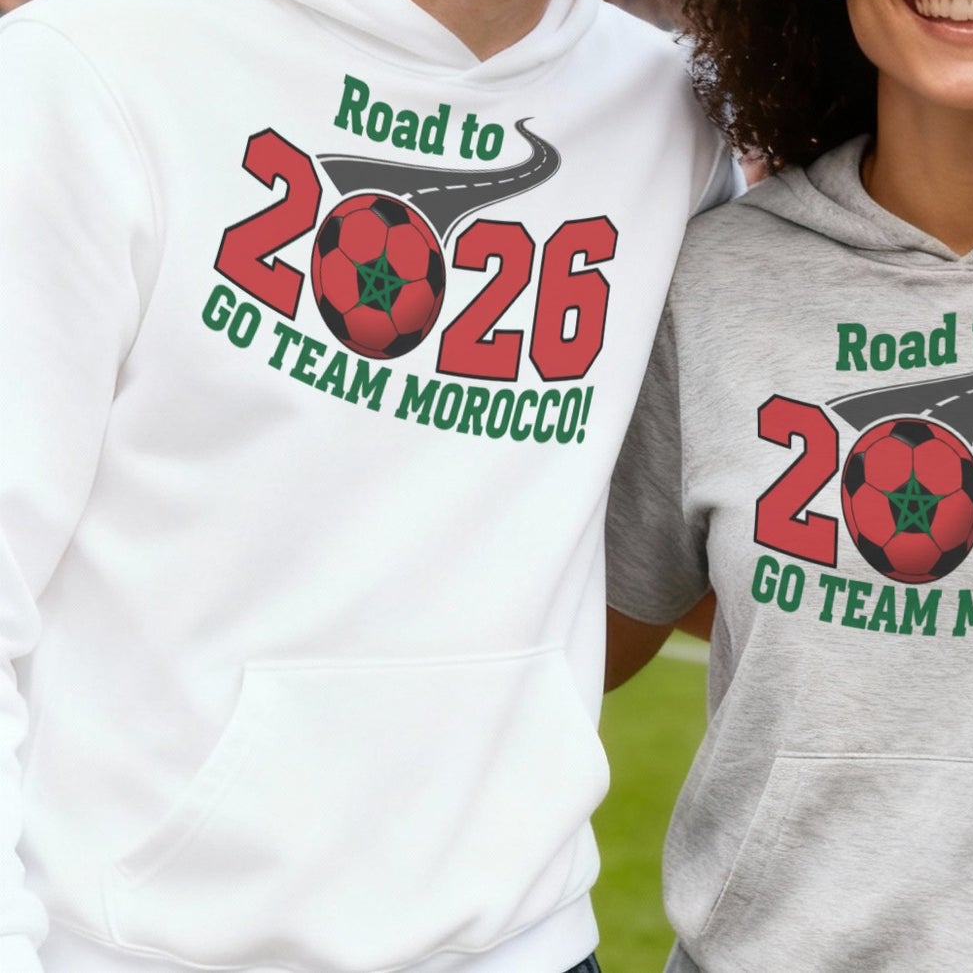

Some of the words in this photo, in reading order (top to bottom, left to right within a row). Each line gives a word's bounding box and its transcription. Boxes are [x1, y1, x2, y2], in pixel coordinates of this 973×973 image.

[334, 74, 451, 156] Road
[459, 112, 505, 161] to
[213, 127, 619, 382] 2026
[201, 284, 262, 348] GO
[268, 321, 392, 412] TEAM
[394, 374, 594, 444] MOROCCO!
[835, 312, 958, 371] Road
[751, 554, 806, 612] GO
[819, 572, 942, 636] TEAM
